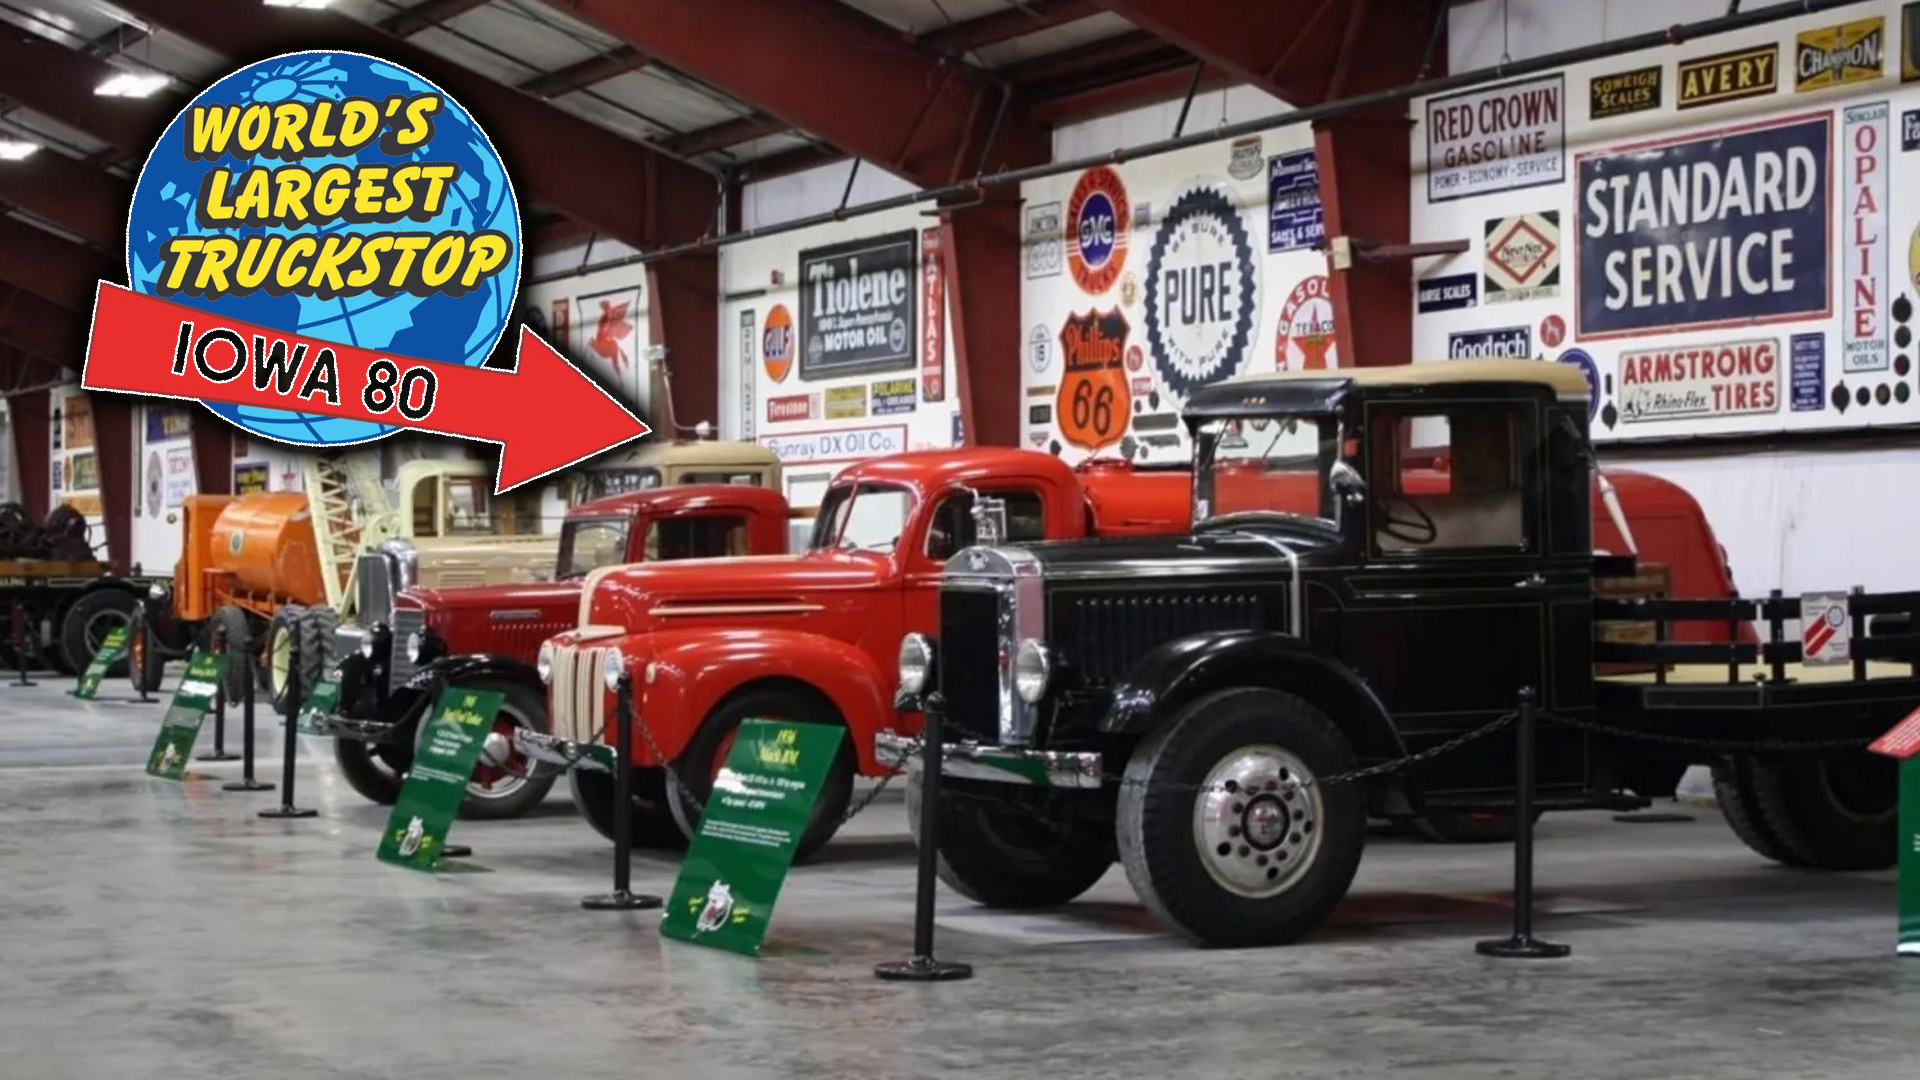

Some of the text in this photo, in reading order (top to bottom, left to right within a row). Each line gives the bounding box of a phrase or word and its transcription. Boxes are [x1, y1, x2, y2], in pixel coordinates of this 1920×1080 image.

[1800, 33, 1877, 77] CHAMPION
[1594, 71, 1658, 98] SOWEIGH
[1684, 57, 1770, 97] AVERY
[1433, 86, 1558, 144] RED CROWN
[1601, 87, 1651, 108] SCALES
[1444, 131, 1545, 168] GASOLINE
[1516, 157, 1557, 176] SERVICE
[1586, 146, 1817, 238] STANDARD
[1081, 215, 1112, 248] GMC
[1191, 221, 1224, 247] SURE
[1854, 125, 1877, 338] OPALINE
[809, 257, 906, 318] Tiolene
[1604, 228, 1795, 311] SERVICE
[926, 253, 938, 362] ATLAS
[1164, 261, 1232, 328] PURE
[765, 325, 793, 358] GULF
[824, 325, 888, 352] MOTOR OIL
[1065, 318, 1120, 366] Phillips
[1168, 328, 1229, 367] WITH PURE
[1451, 333, 1526, 360] Goodrich
[1846, 340, 1884, 352] MOTOR
[1623, 344, 1774, 385] ARMSTRONG
[1853, 353, 1879, 365] OILS
[1073, 378, 1114, 437] 66
[1711, 381, 1775, 411] TIRES
[767, 431, 896, 461] Sunray DX Oil Co.
